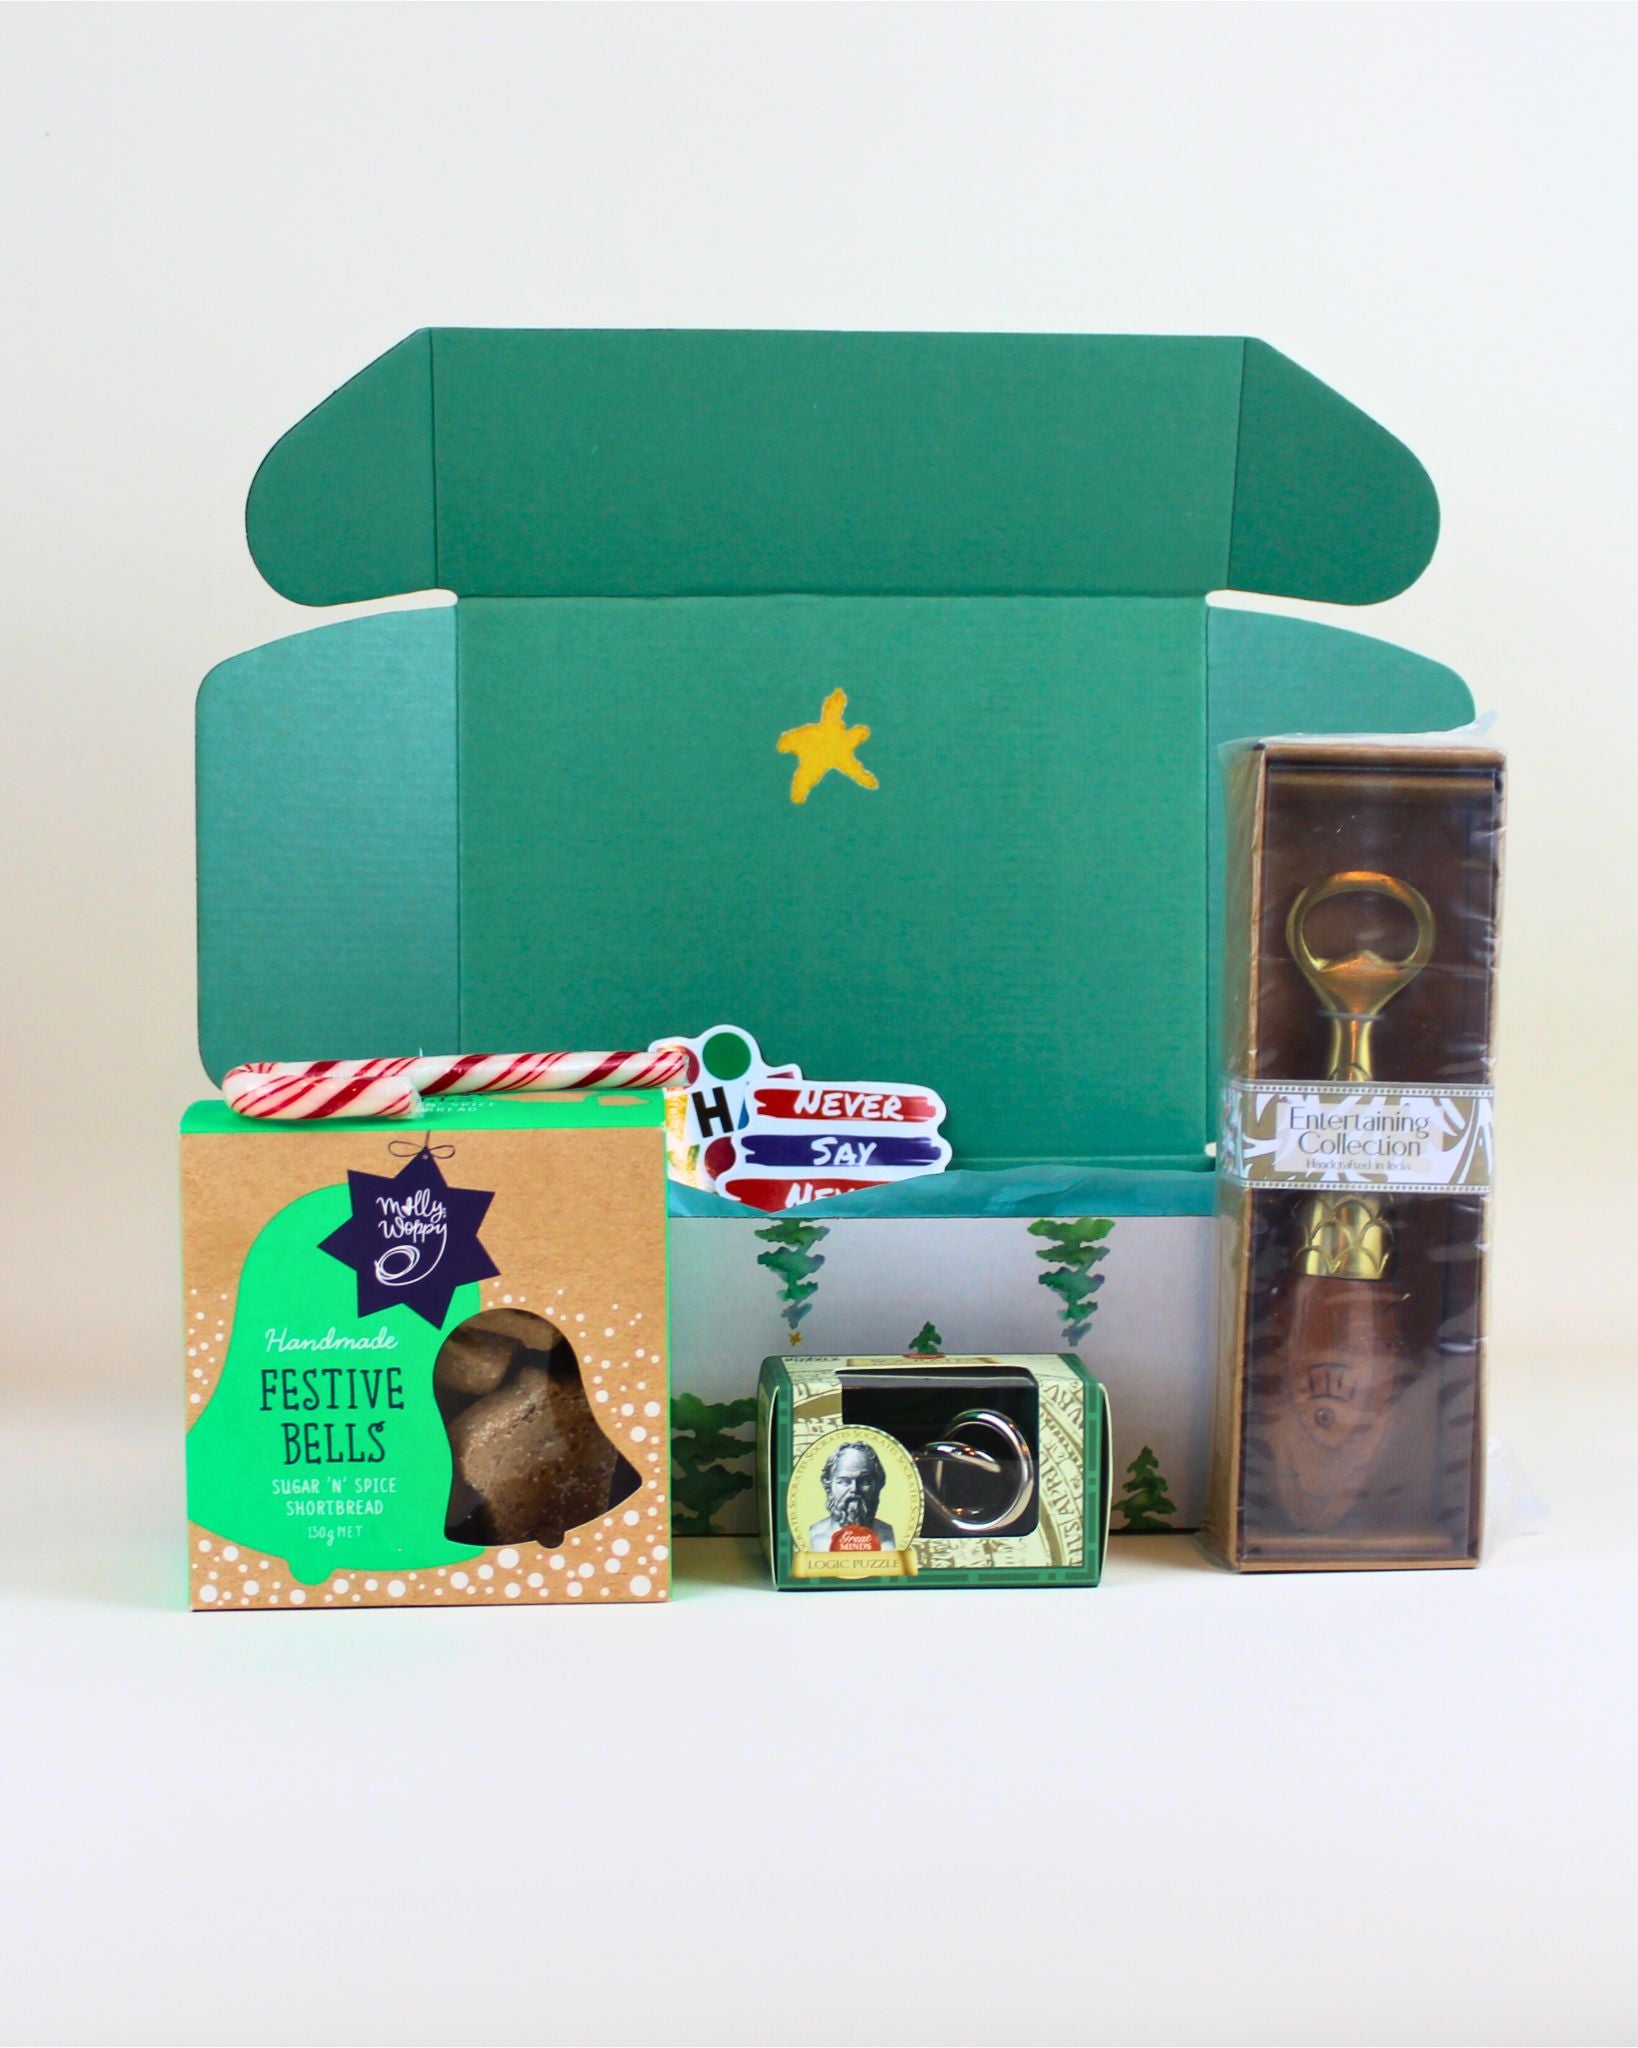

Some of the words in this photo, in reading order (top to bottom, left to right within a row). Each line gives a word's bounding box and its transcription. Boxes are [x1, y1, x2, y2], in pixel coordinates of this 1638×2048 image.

[691, 1085, 734, 1139] H
[793, 1088, 905, 1121] NEVER
[1289, 1105, 1432, 1139] Entertaining
[810, 1136, 877, 1167] SAY
[1298, 1130, 1421, 1156] Collection
[1306, 1159, 1371, 1170] Handcrafted
[1375, 1160, 1384, 1170] in
[1387, 1160, 1412, 1171] India
[264, 1326, 399, 1352] Handmade
[259, 1366, 405, 1411] FESTIVE
[280, 1420, 386, 1466] BELLS
[272, 1478, 320, 1495] SUGAR
[354, 1477, 397, 1494] SPICE
[286, 1499, 384, 1516] SHORTBREAD
[337, 1525, 363, 1538] NET
[839, 1530, 873, 1543] Great
[840, 1542, 873, 1551] MINDS
[808, 1559, 847, 1570] LOGIC
[852, 1558, 900, 1569] PUZZLE
